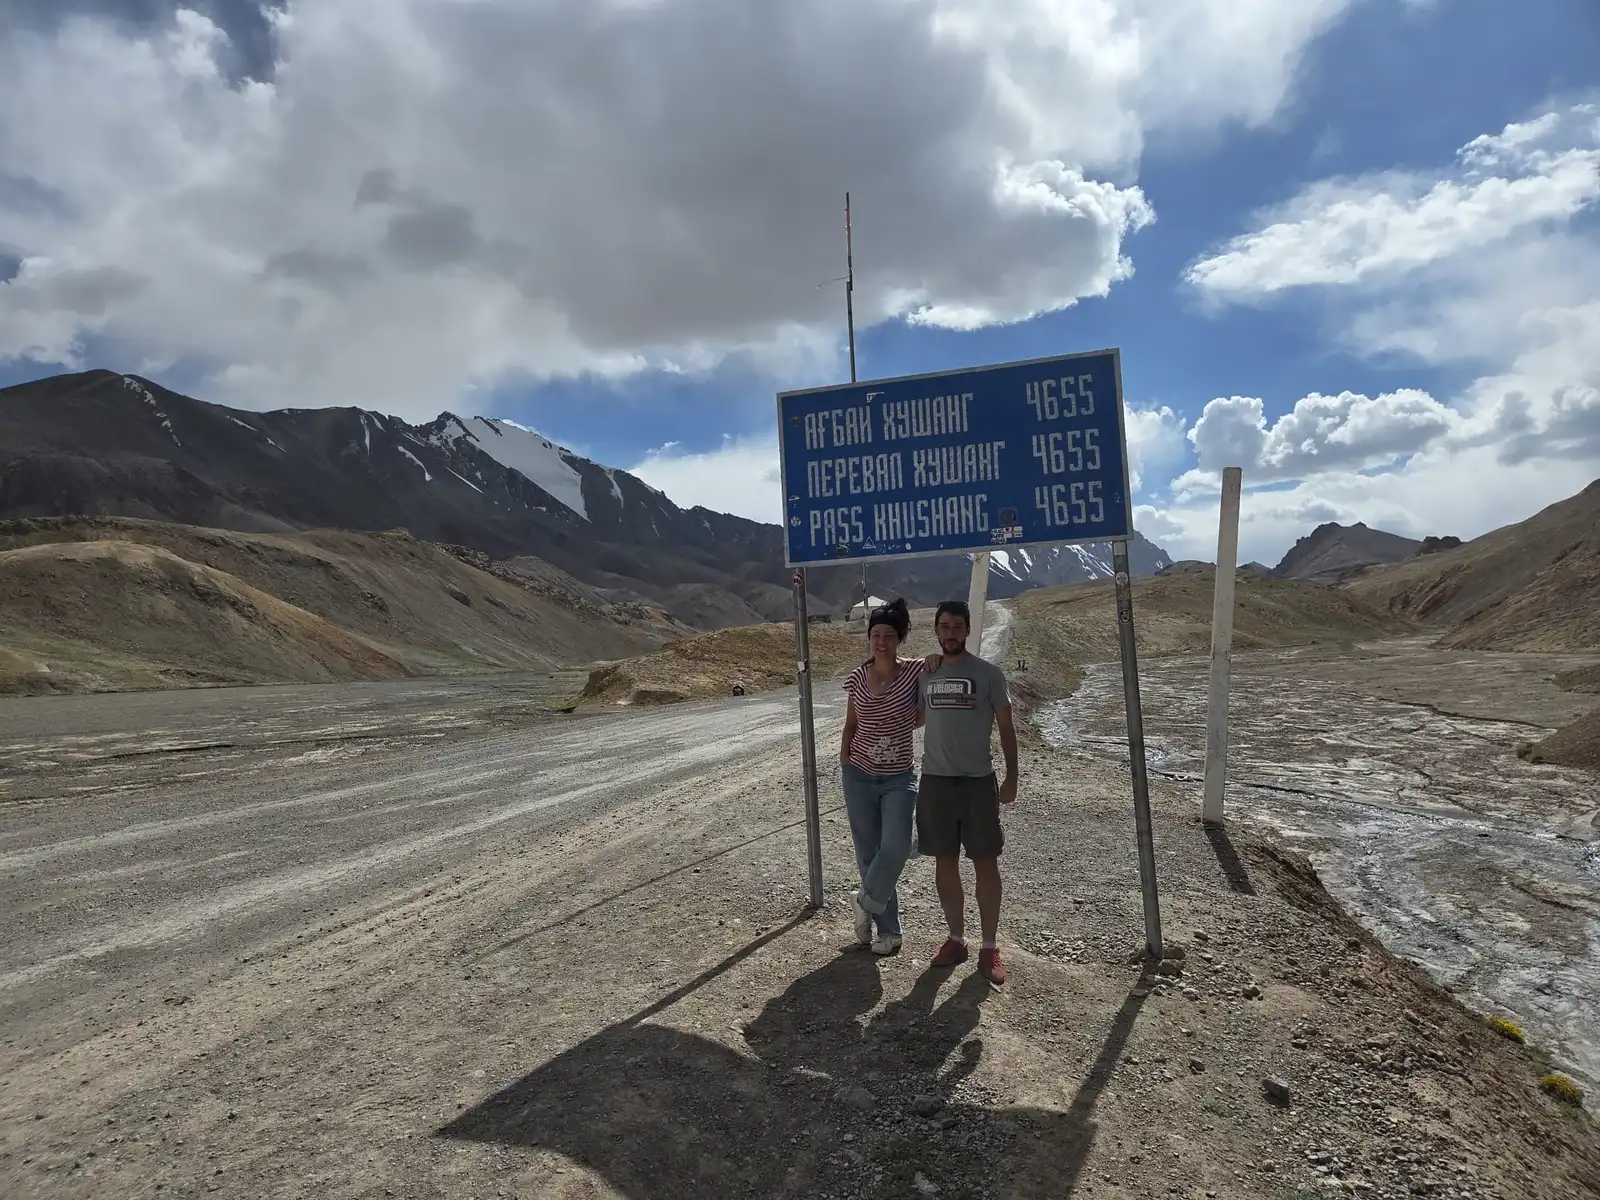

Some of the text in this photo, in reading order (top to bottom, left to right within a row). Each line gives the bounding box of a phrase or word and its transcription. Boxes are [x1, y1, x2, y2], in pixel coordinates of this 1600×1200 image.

[882, 393, 973, 441] ХУШАНГ
[1026, 373, 1095, 422] 4655
[807, 441, 1006, 498] ПЕРЕВАЛ ХУШАНГ
[1032, 428, 1101, 475] 4655
[809, 494, 990, 547] PASS KHUSHANG
[1034, 480, 1105, 527] 4655
